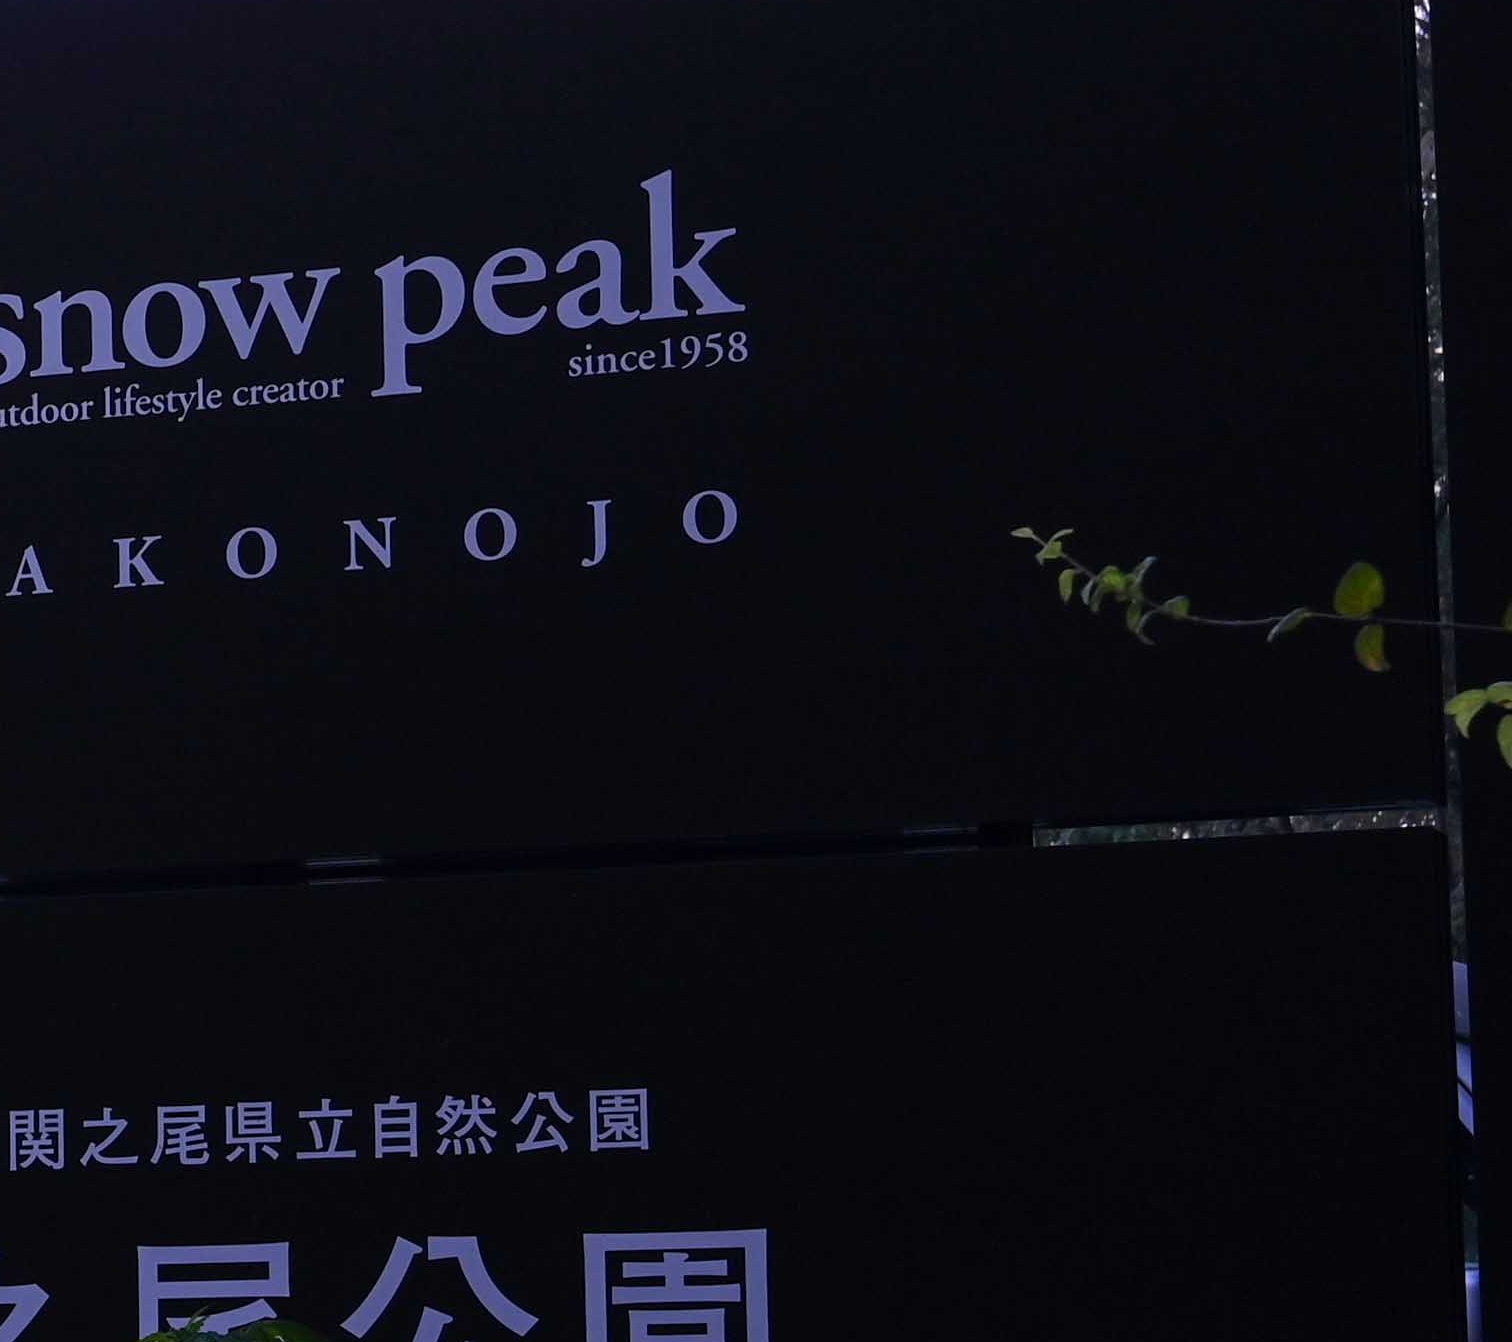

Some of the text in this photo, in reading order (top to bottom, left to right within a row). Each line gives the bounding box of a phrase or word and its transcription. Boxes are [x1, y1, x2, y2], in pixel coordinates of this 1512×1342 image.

[371, 169, 746, 397] peak
[568, 332, 748, 377] since1958
[102, 378, 223, 425] lifestyle
[232, 378, 345, 407] creator
